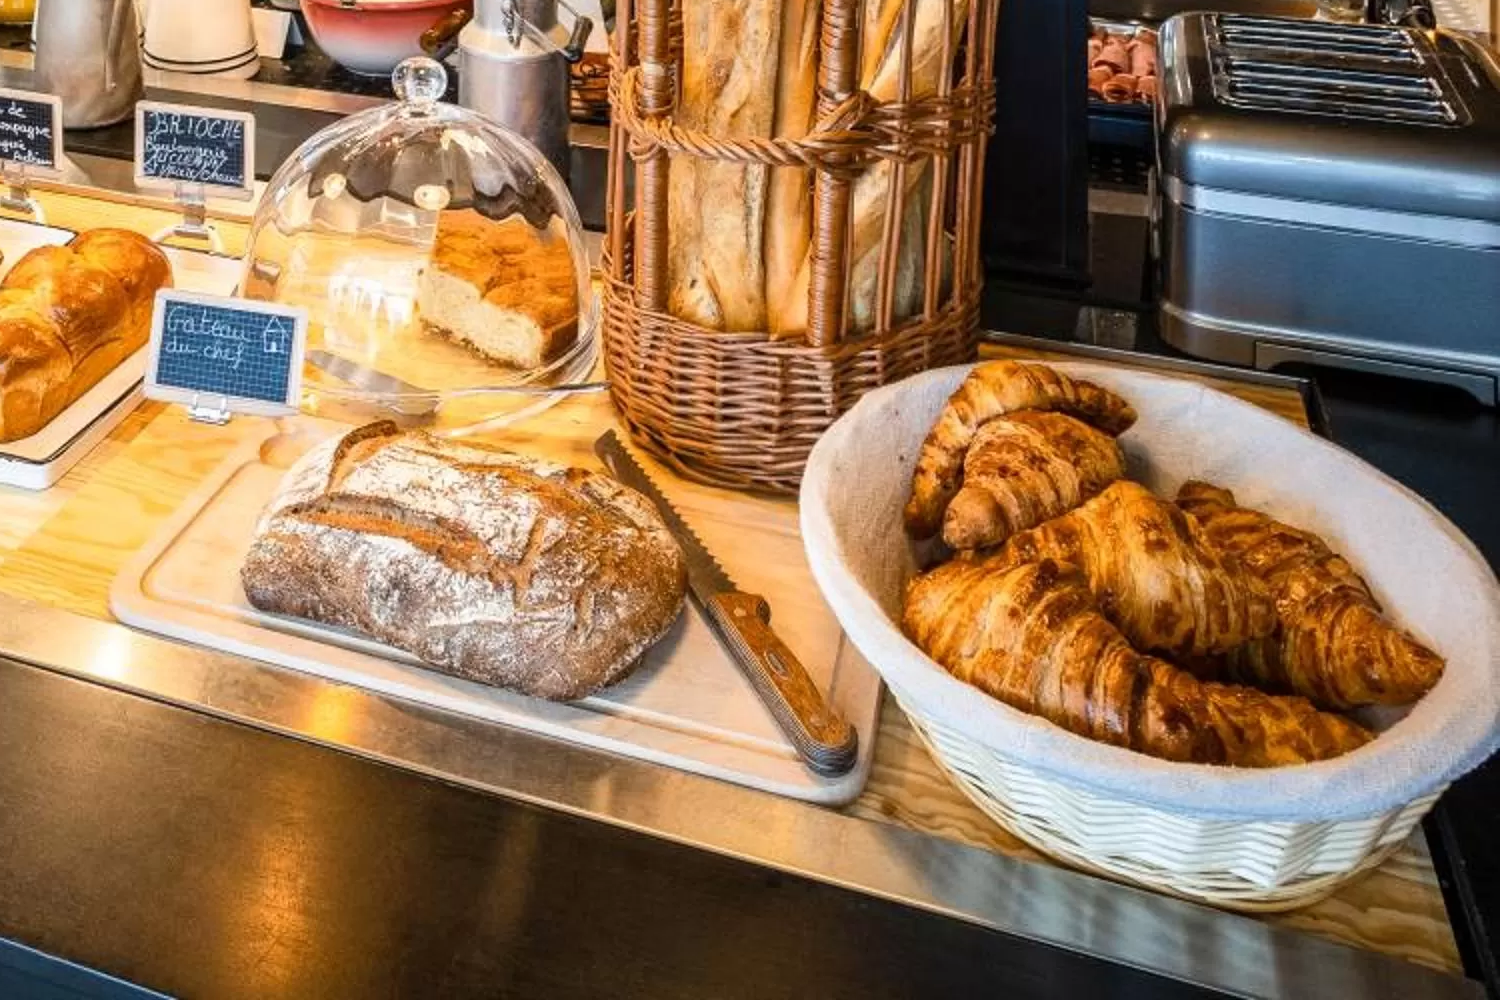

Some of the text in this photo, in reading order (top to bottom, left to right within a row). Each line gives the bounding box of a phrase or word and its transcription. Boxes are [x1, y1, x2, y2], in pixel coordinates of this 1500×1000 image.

[8, 101, 27, 118] de
[149, 111, 241, 141] BRIOCHE
[165, 336, 198, 352] du
